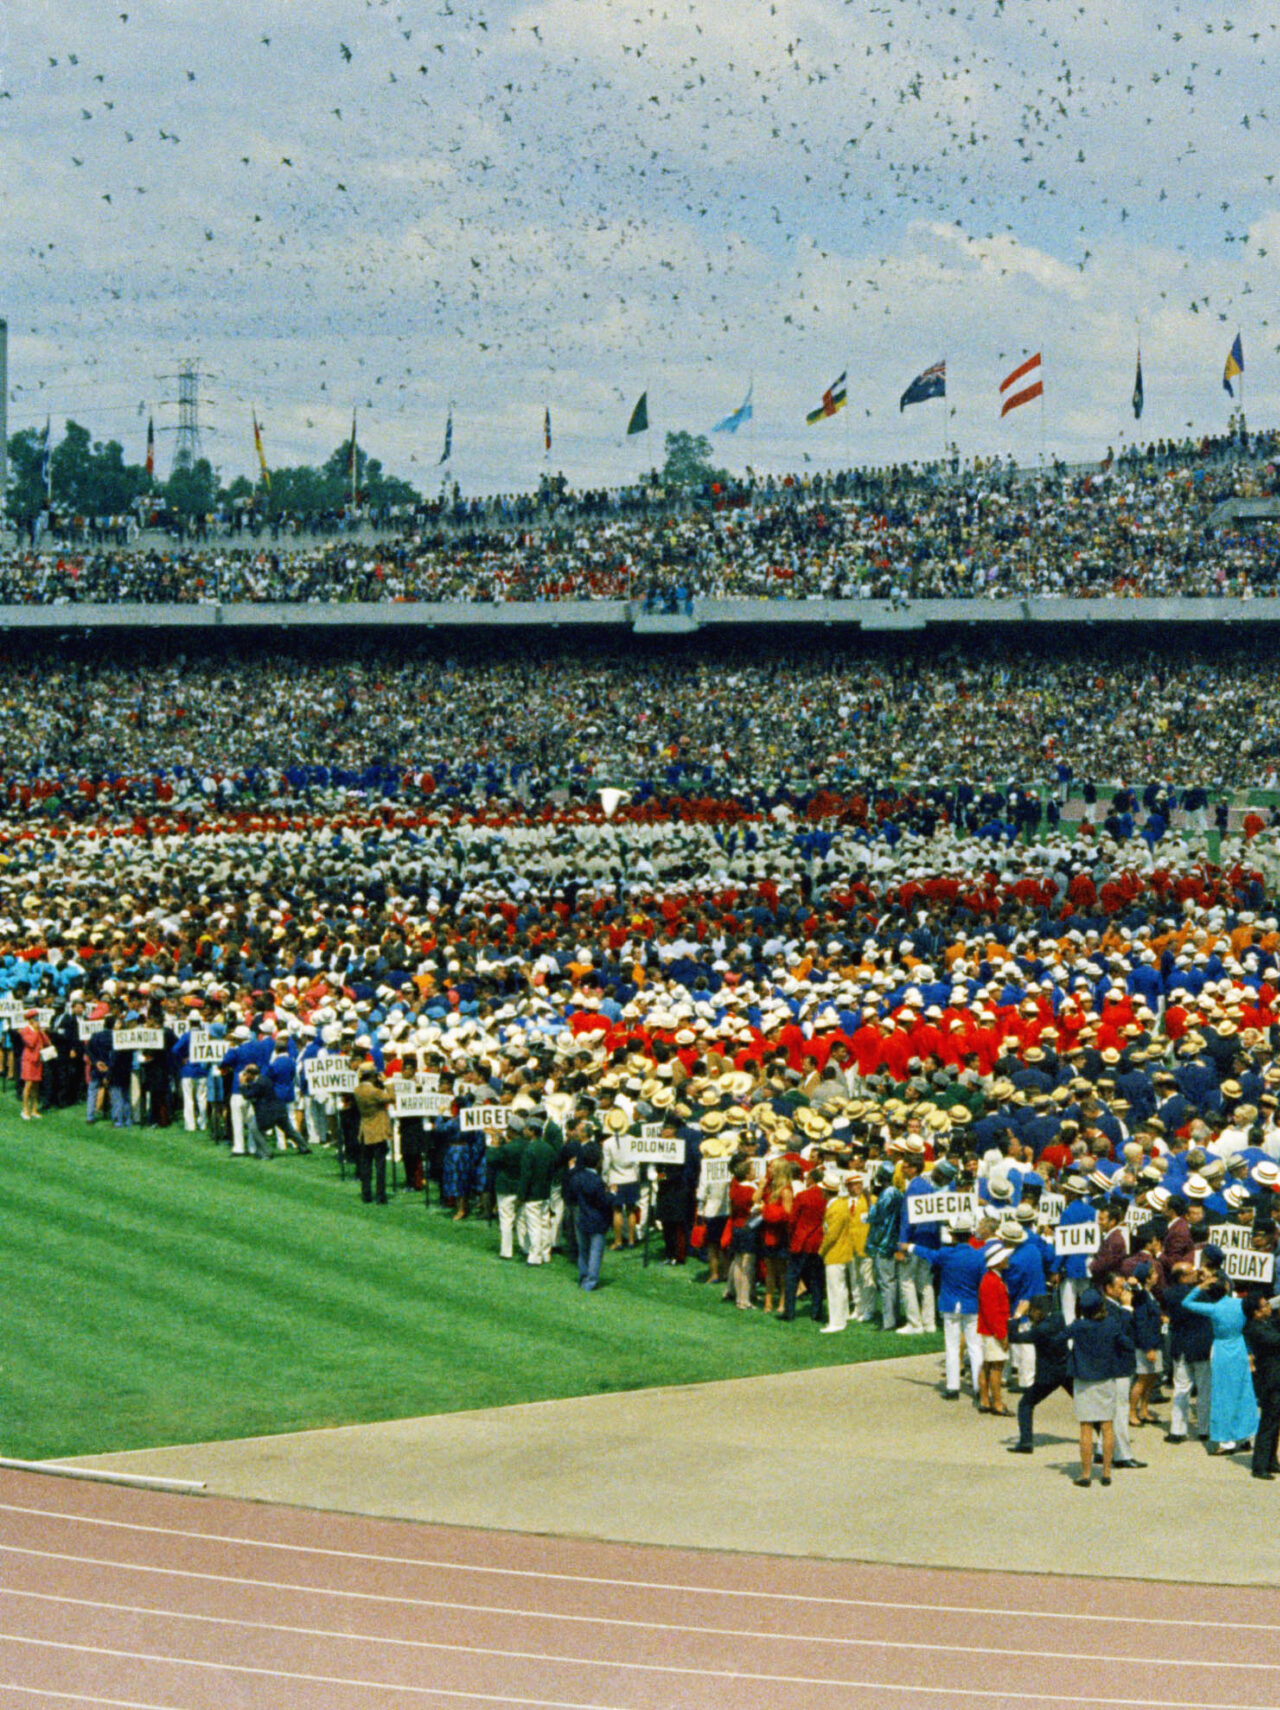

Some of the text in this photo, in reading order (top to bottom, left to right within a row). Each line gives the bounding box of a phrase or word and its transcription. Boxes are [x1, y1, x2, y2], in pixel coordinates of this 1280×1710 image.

[115, 1030, 158, 1044] ISLANDIA
[312, 1073, 356, 1089] KUWEIT
[630, 1140, 677, 1153] POLONIA
[914, 1196, 972, 1215] SUECIA
[1059, 1227, 1096, 1247] TUN
